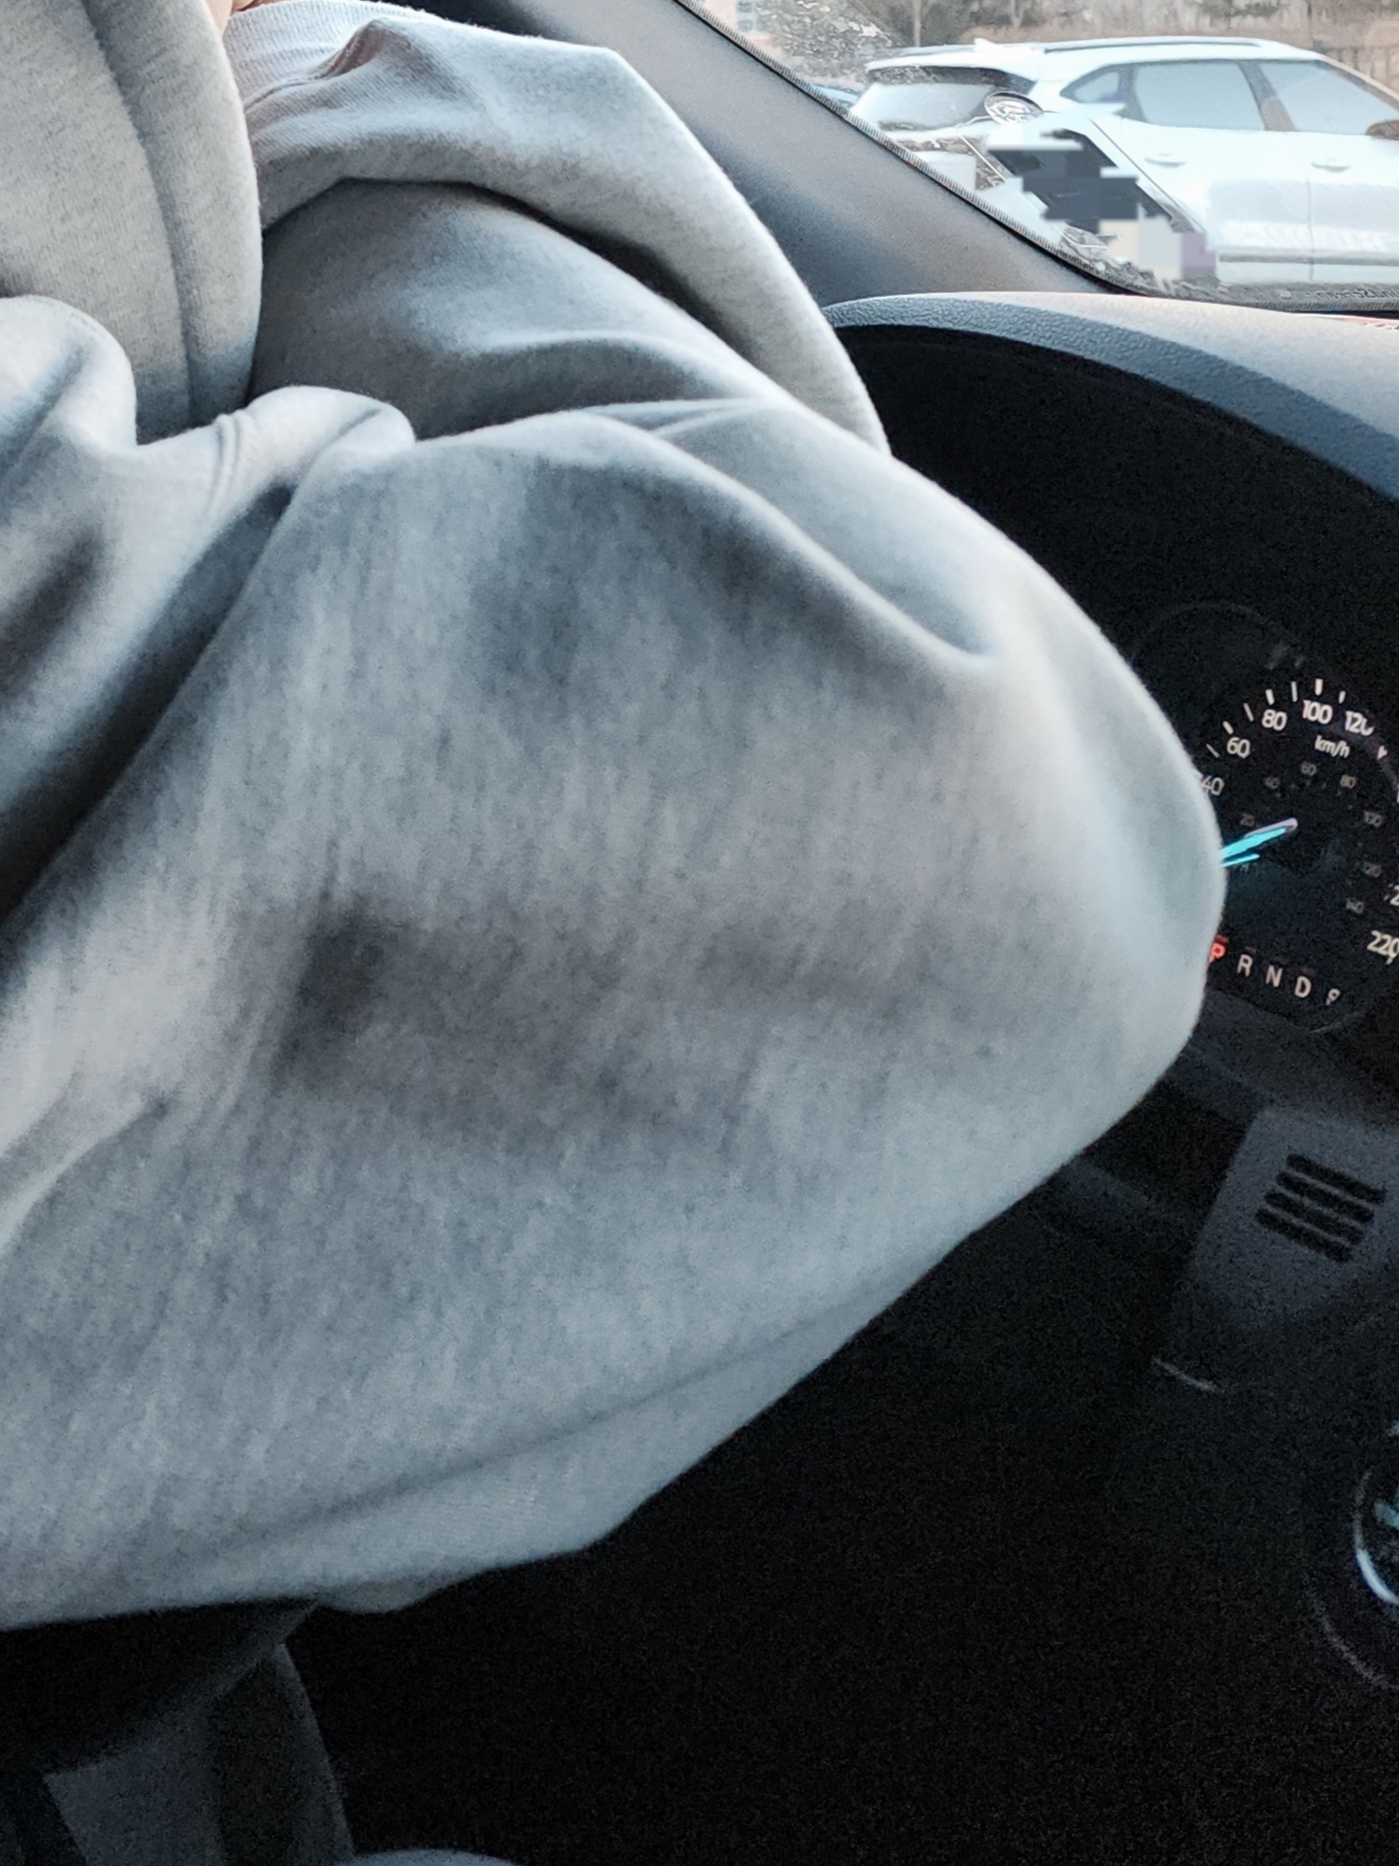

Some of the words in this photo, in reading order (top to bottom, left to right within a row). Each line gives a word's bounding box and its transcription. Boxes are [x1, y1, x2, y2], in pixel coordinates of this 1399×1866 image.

[1261, 709, 1287, 731] 80
[1303, 699, 1333, 724] 100
[1226, 737, 1251, 758] 60
[1315, 735, 1350, 758] km/h
[1301, 762, 1317, 776] 60
[1340, 774, 1356, 789] 80
[1366, 930, 1399, 958] 220
[1209, 943, 1226, 963] P
[1237, 954, 1253, 977] R
[1265, 965, 1283, 988] N
[1294, 976, 1312, 998] D
